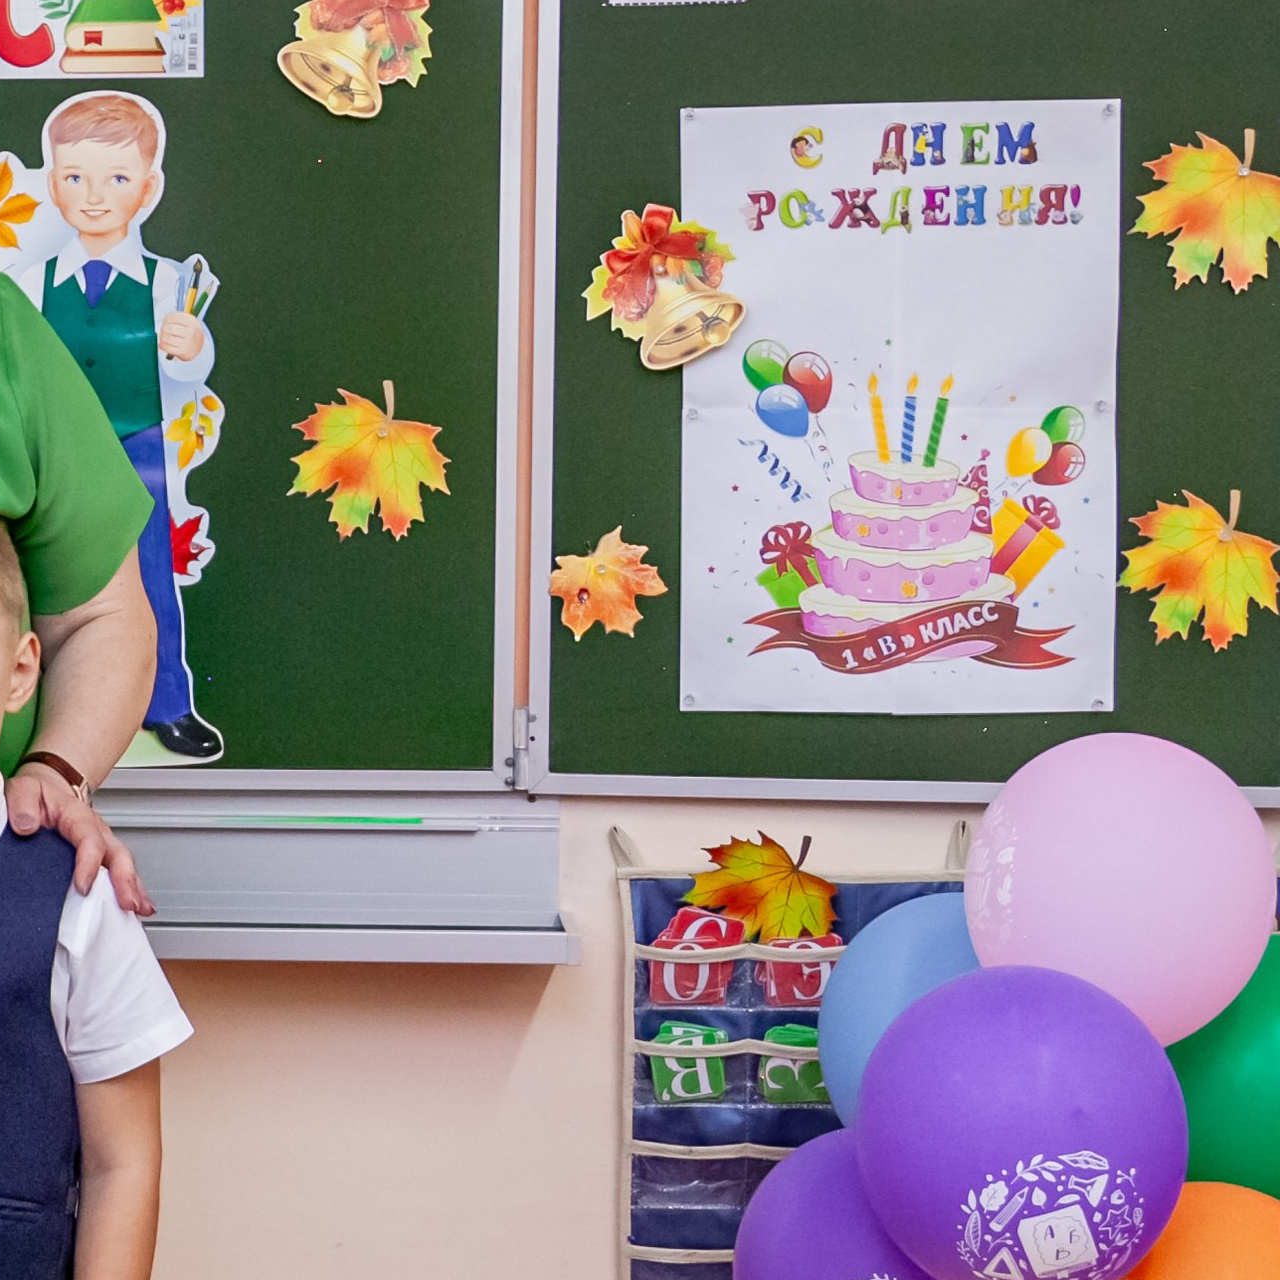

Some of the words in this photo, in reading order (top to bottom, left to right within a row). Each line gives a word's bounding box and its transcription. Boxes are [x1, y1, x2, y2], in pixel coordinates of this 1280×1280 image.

[789, 126, 825, 169] С
[872, 121, 1038, 176] ДНЕМ
[737, 183, 1083, 234] РОЖДЕНИЯ!
[841, 649, 859, 669] 1
[919, 602, 999, 644] КЛАСС
